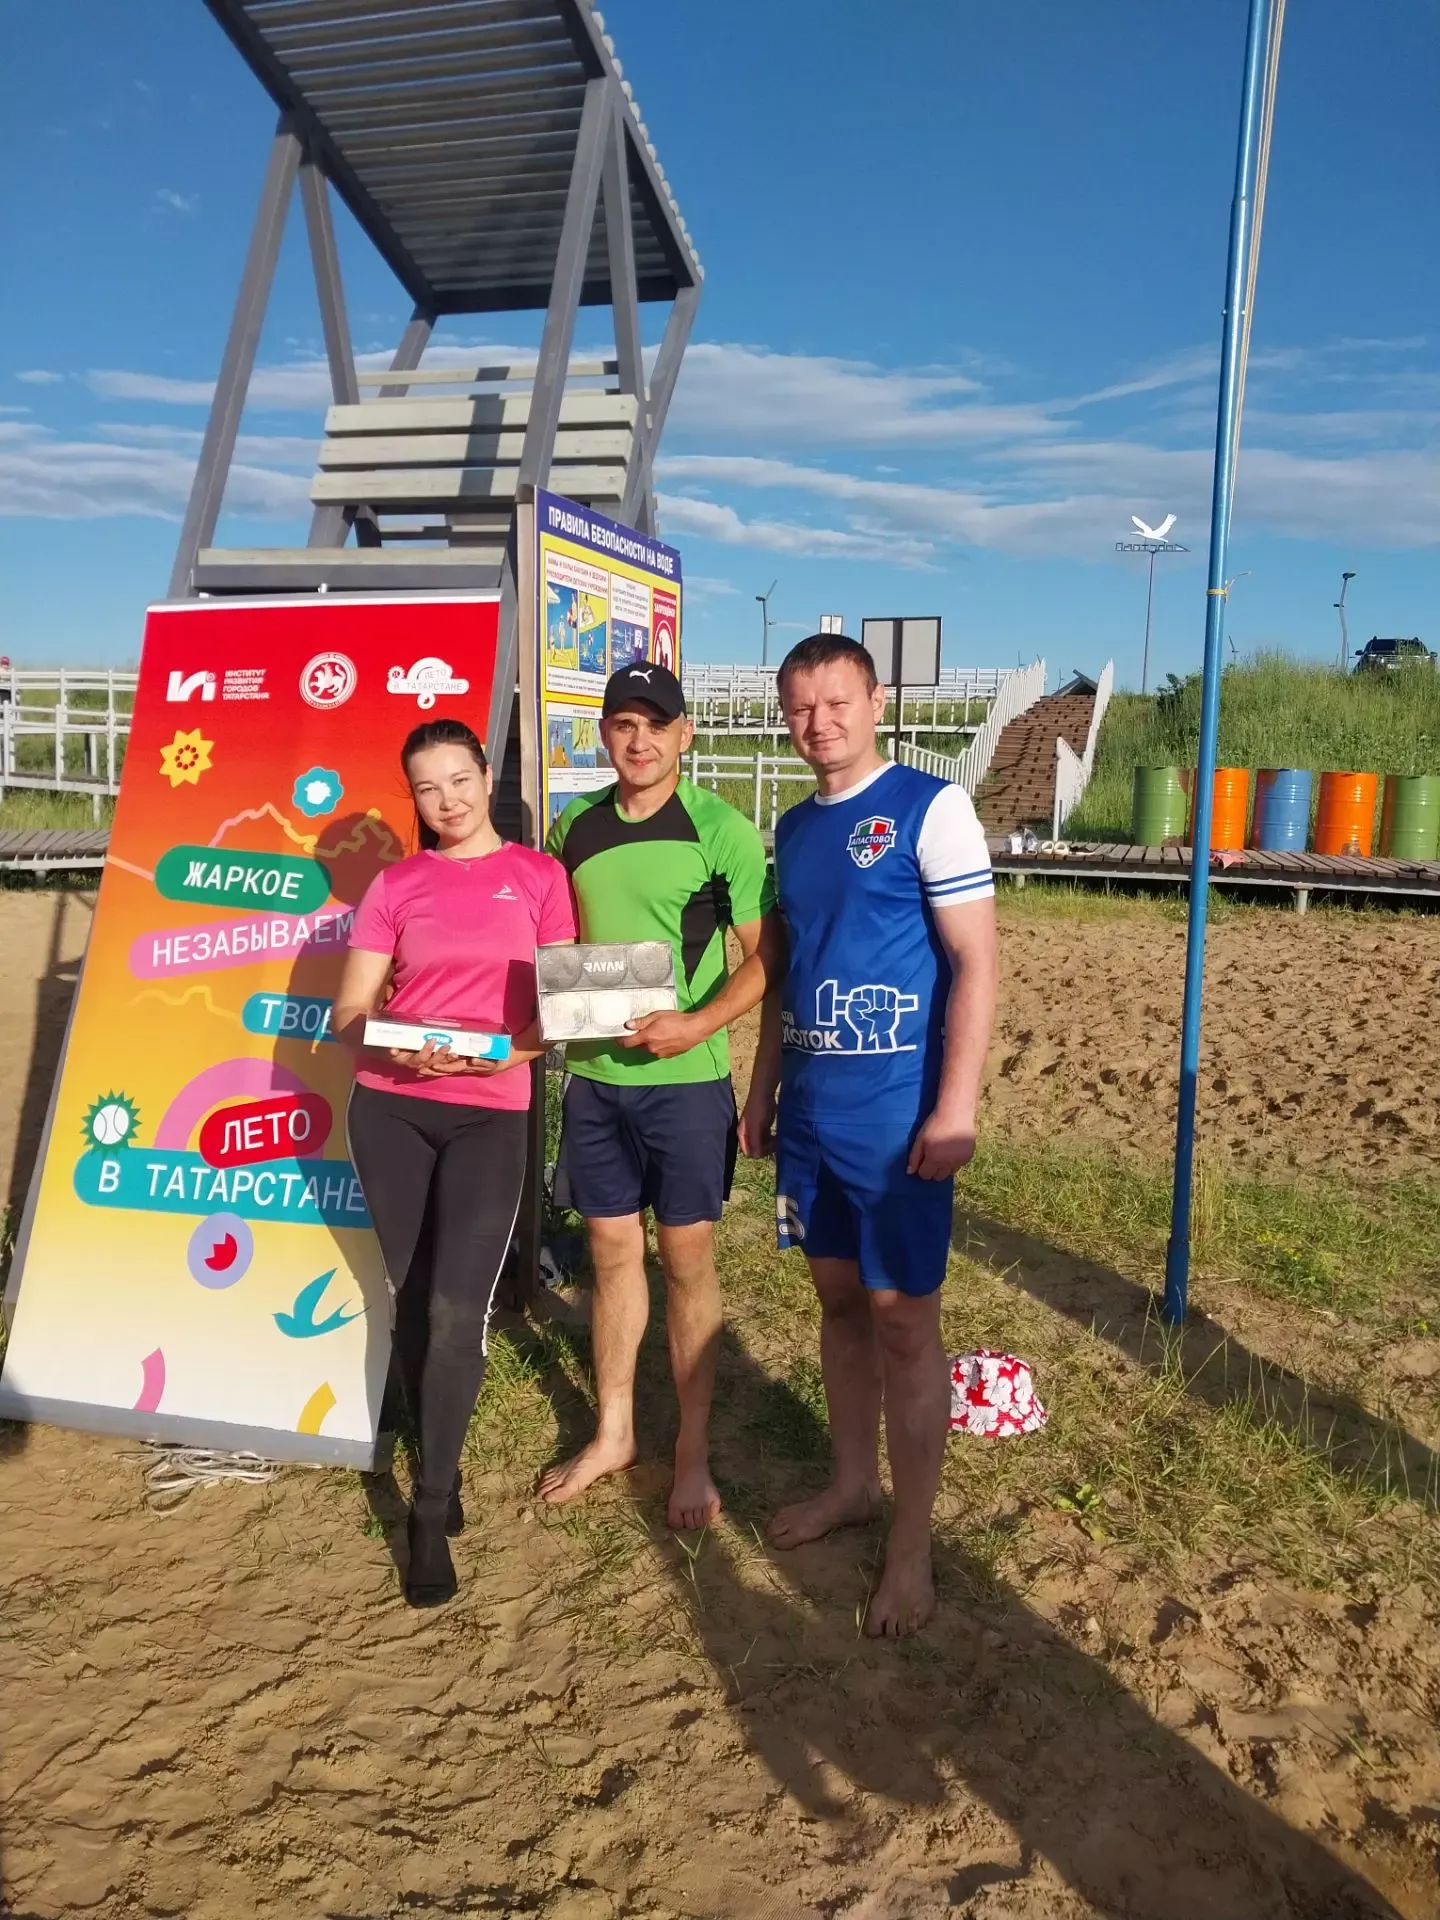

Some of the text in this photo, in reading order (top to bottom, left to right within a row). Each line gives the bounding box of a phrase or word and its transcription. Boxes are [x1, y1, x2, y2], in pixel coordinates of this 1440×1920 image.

[548, 506, 674, 575] ПРАВИЛА БЕЗОПАСНОСТИ НА ВОДЕ
[225, 669, 266, 678] ИНСТИТУТ
[222, 685, 260, 693] ГОРОДОВ
[222, 692, 270, 701] ТАТАРСТАНА
[405, 682, 463, 691] ТАТАРСТАНЕ
[851, 835, 891, 846] АПАСТОВО
[183, 861, 304, 900] ЖАРКОЕ
[152, 911, 354, 967] НЕЗАБЫВАЕМ
[220, 1108, 311, 1155] ЛЕТО
[98, 1160, 367, 1213] В ТАТАРСТАНЕ
